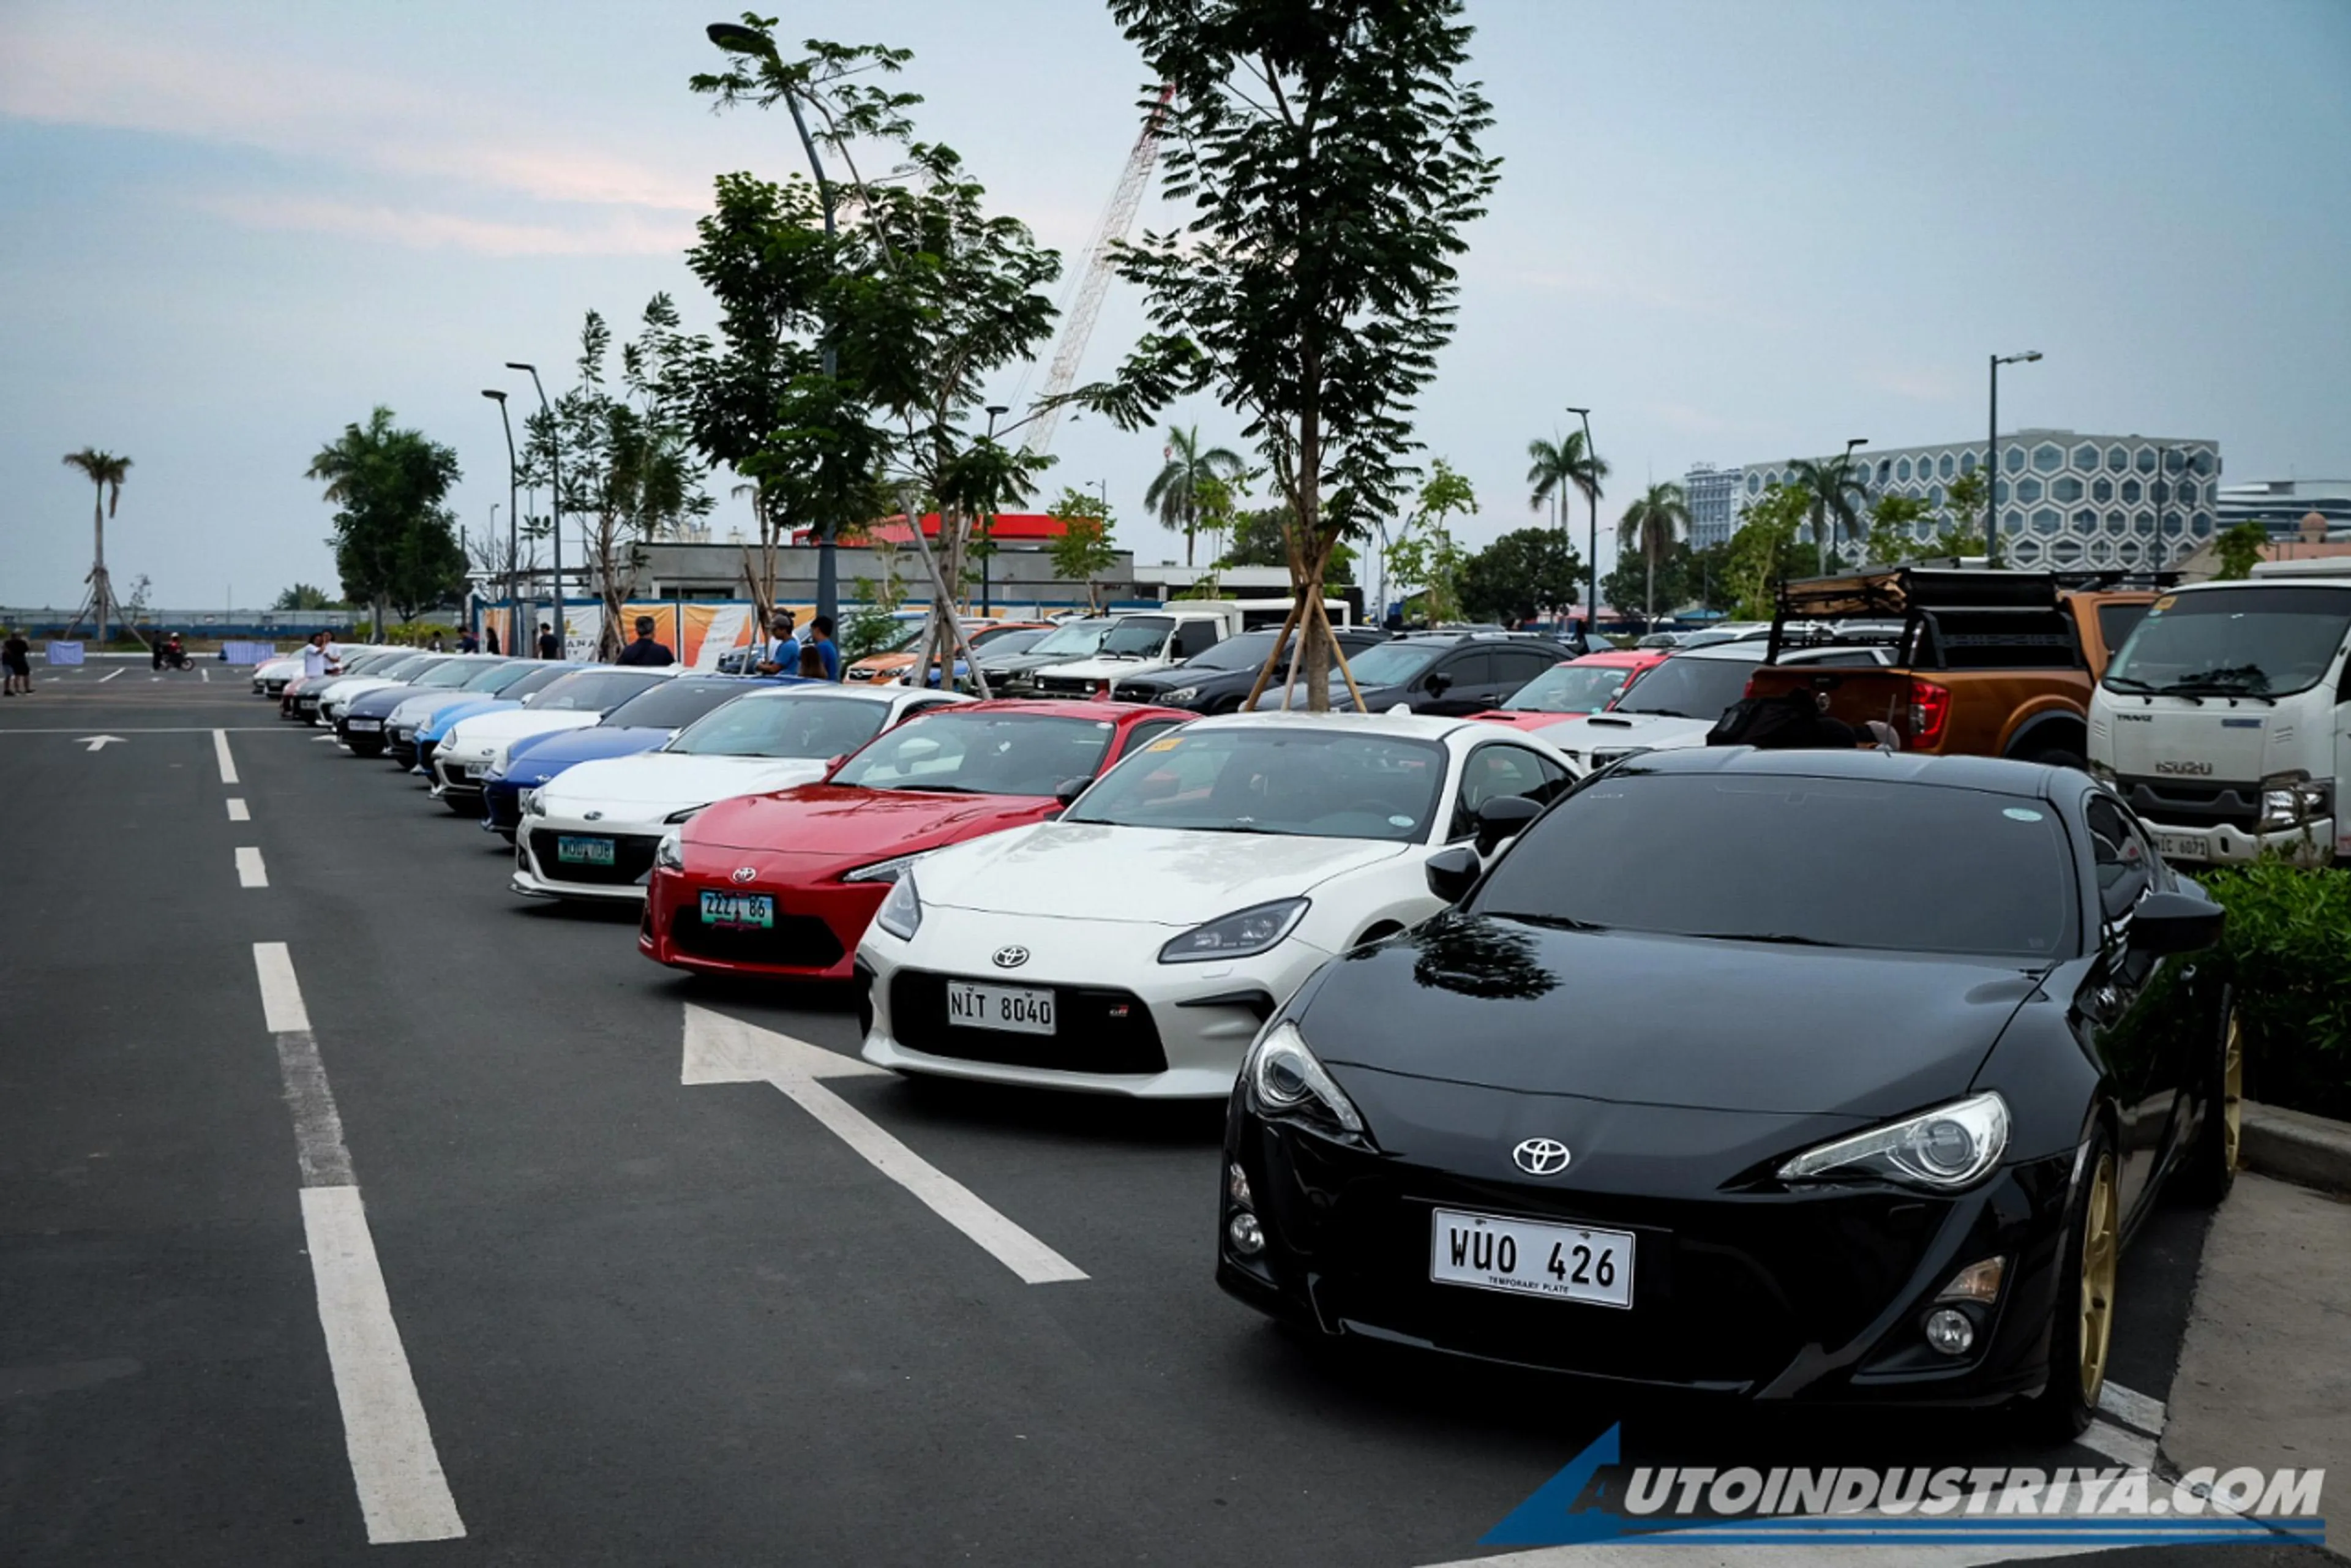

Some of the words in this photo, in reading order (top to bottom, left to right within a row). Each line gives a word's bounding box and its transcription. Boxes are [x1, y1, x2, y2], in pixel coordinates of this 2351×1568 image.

[2155, 760, 2213, 776] ISUZU
[749, 898, 765, 918] 86
[951, 991, 986, 1018] NIT
[1000, 997, 1051, 1024] 8040
[1547, 1242, 1615, 1287] 426
[1488, 1276, 1539, 1289] TEMPORARY
[1543, 1283, 1569, 1294] PLATE
